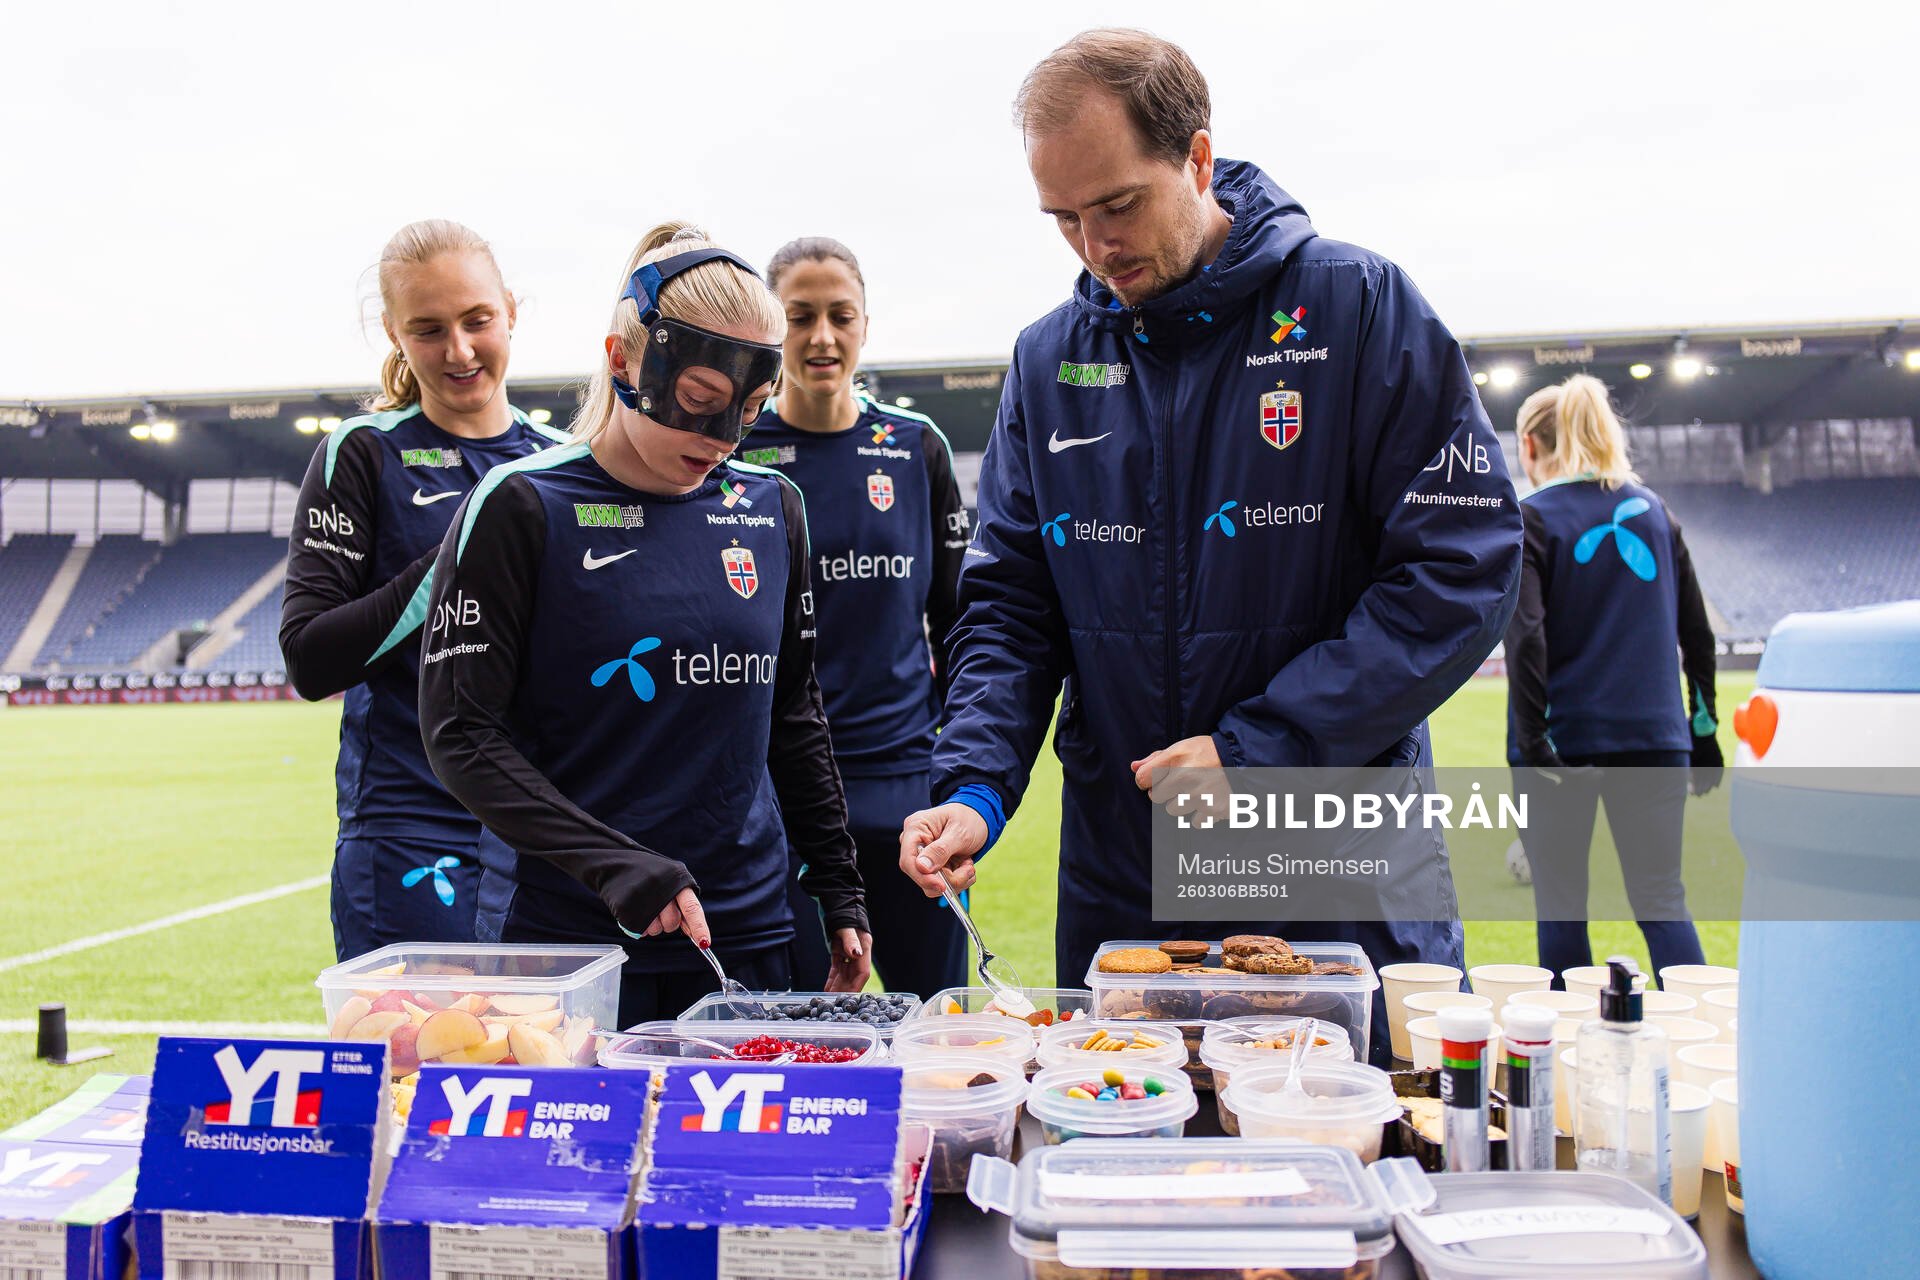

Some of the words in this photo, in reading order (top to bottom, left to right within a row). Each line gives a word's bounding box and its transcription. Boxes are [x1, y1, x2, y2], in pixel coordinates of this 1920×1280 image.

[1246, 351, 1282, 367] Norsk
[1283, 347, 1328, 363] Tipping
[1057, 361, 1109, 387] KIWI
[401, 448, 442, 467] KIWI
[883, 447, 912, 460] Tipping
[1404, 492, 1503, 507] #huninvesterer
[308, 504, 354, 537] DNB
[574, 503, 624, 527] KIWI
[622, 505, 643, 517] mini
[706, 514, 738, 525] Norsk
[738, 514, 775, 527] Tipping
[1244, 502, 1324, 527] telenor
[624, 516, 644, 529] pris
[1074, 519, 1145, 544] telenor
[819, 549, 915, 582] telenor
[432, 590, 480, 638] DNB
[672, 643, 777, 684] telenor
[332, 1051, 363, 1062] ETTER
[332, 1063, 372, 1075] TRENING
[213, 1044, 325, 1128] YT
[441, 1074, 533, 1137] YT
[689, 1070, 785, 1133] YT
[789, 1097, 867, 1116] ENERGI
[534, 1102, 611, 1122] ENERGI
[529, 1121, 574, 1139] BAR
[787, 1116, 832, 1135] BAR
[185, 1130, 334, 1155] Restitusjonsbar
